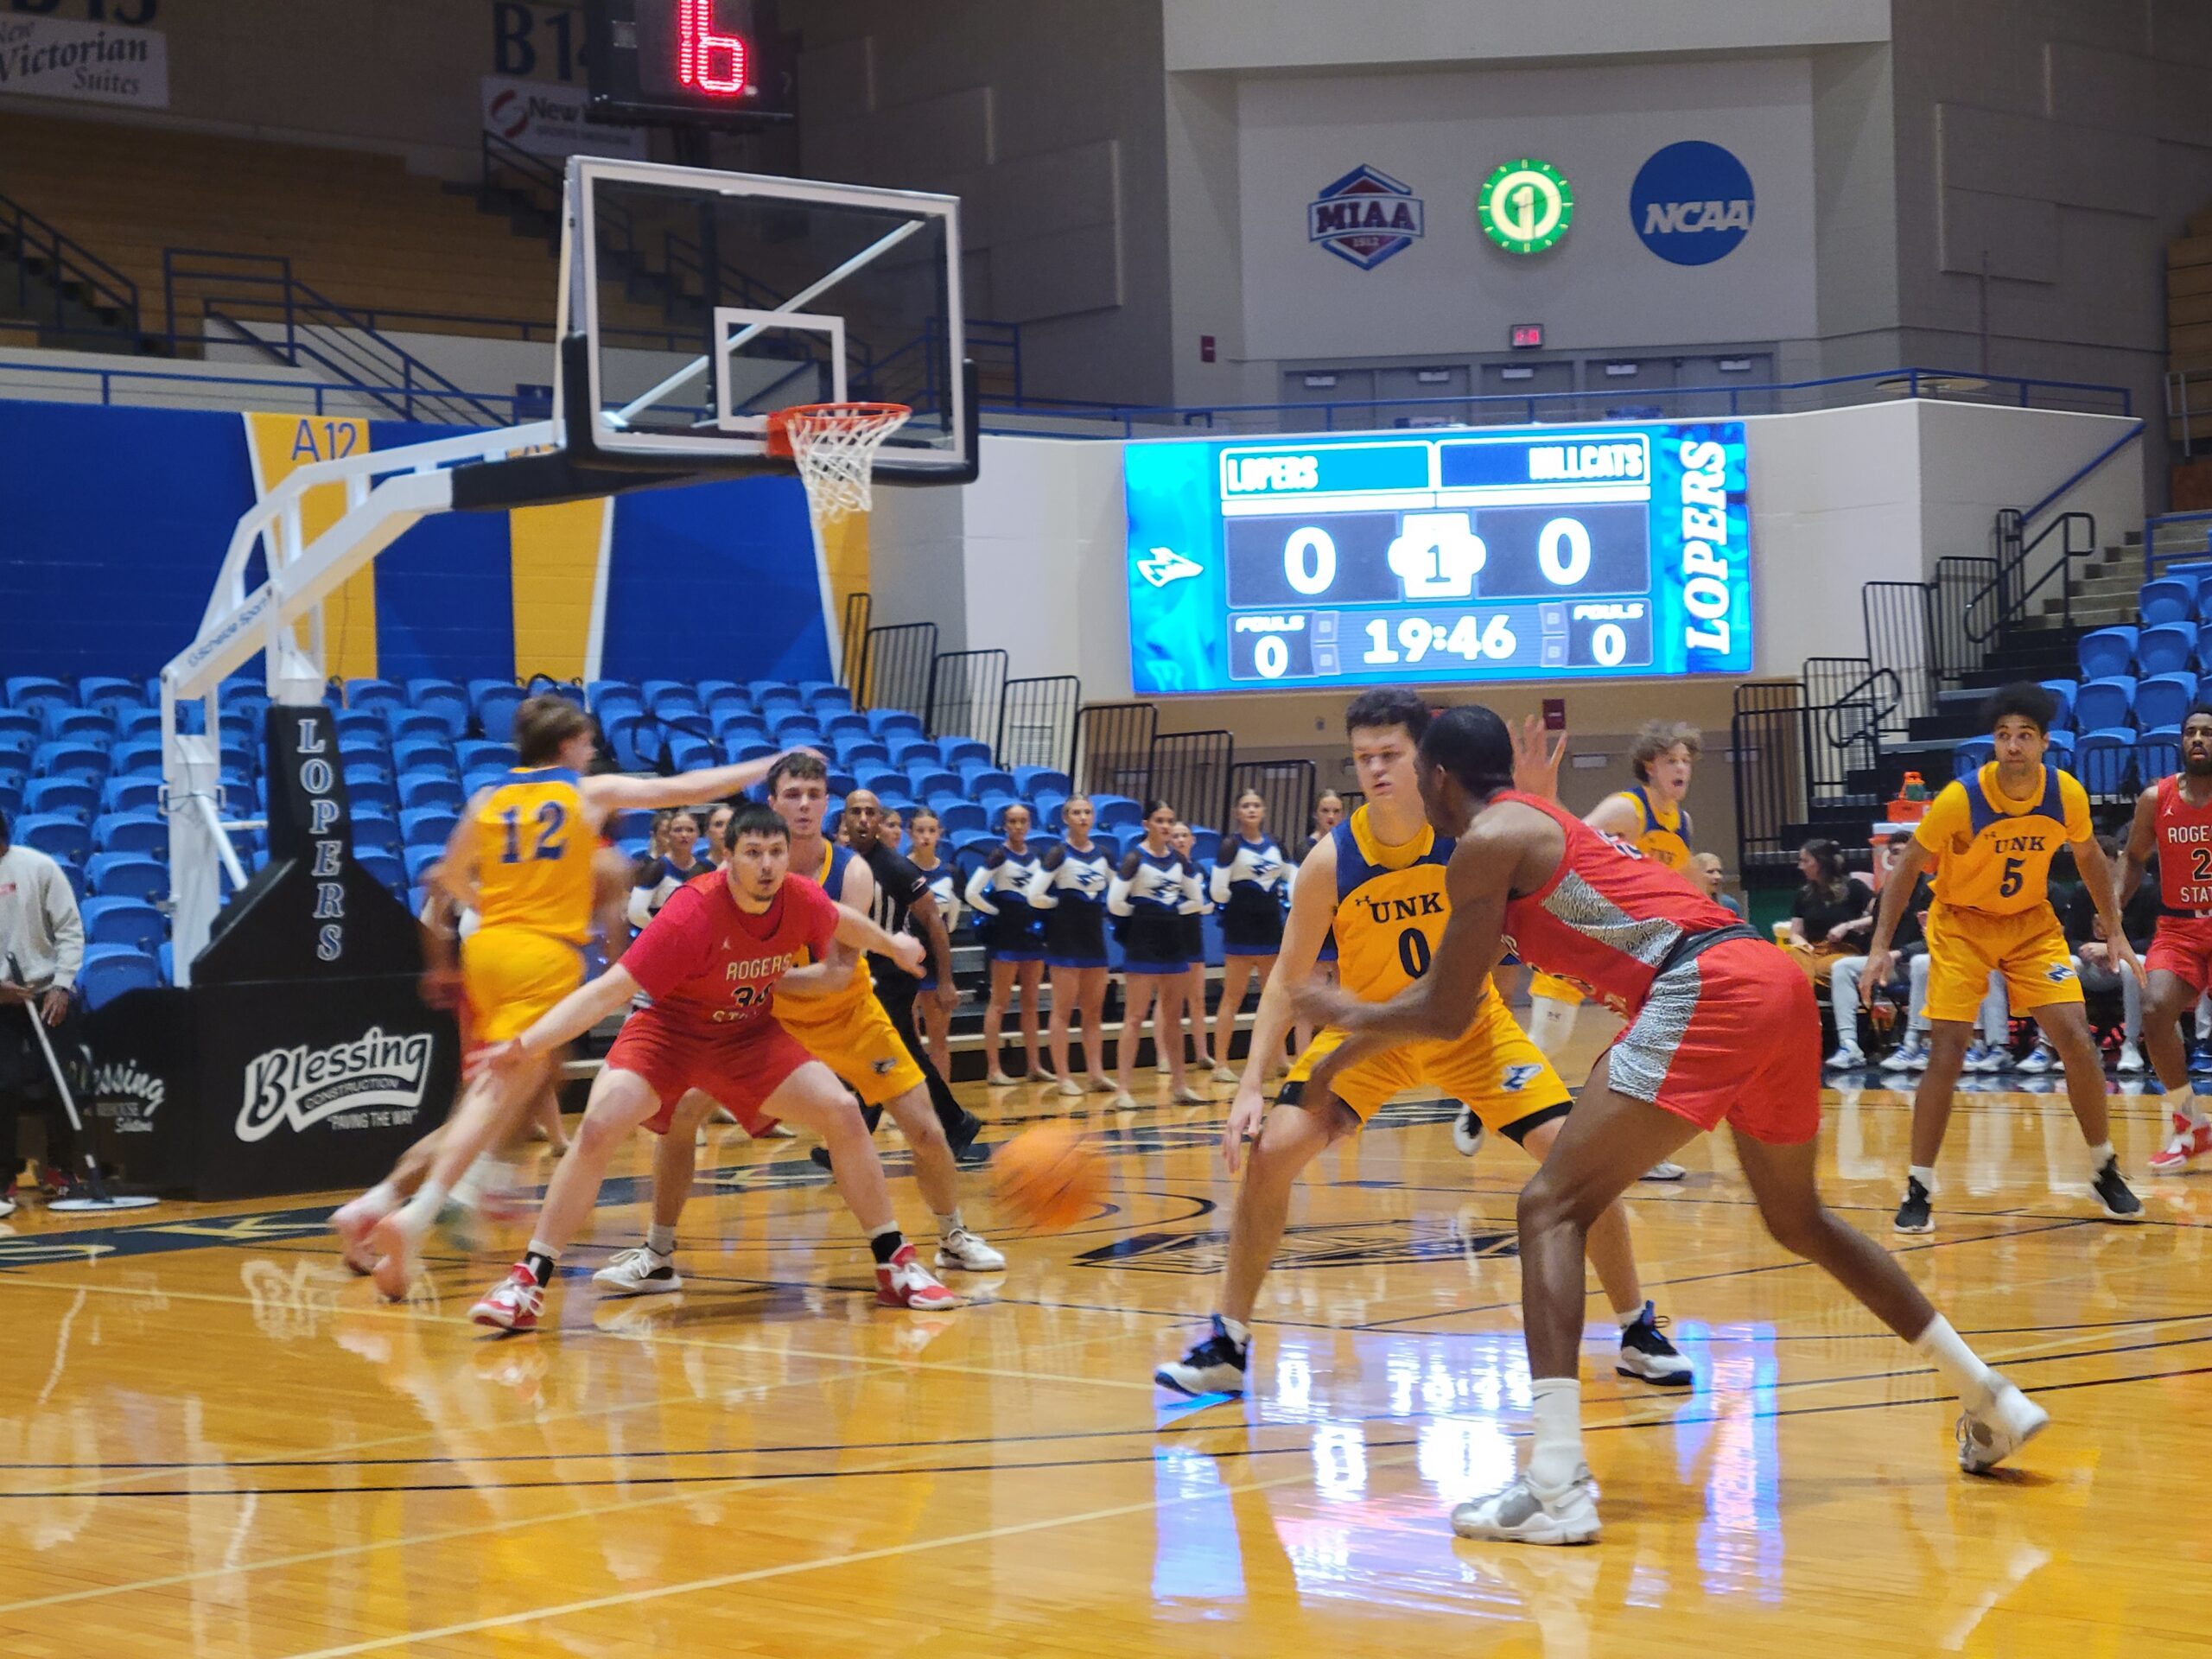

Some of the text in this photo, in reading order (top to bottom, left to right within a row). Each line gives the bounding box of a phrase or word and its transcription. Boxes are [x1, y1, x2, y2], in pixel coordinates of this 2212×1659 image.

[493, 3, 591, 82] B1
[73, 67, 140, 96] Suites
[528, 96, 580, 122] New
[1315, 200, 1416, 234] MIAA
[1643, 200, 1749, 234] NCAA
[1284, 526, 1337, 594] 0
[1426, 544, 1451, 583] 1
[1538, 517, 1591, 586] 0
[1680, 441, 1730, 655] LOPERS
[1254, 635, 1288, 678] 0
[1363, 614, 1517, 664] 19:46
[1592, 623, 1626, 666] 0
[297, 718, 346, 962] LOPERS
[500, 801, 564, 863] 12
[1995, 836, 2046, 854] UNK
[2167, 825, 2212, 844] ROGE
[1999, 857, 2025, 899] 5
[1369, 893, 1445, 923] UNK
[726, 952, 792, 981] ROGERS
[1398, 927, 1431, 980] 0
[238, 1028, 431, 1137] Blessing
